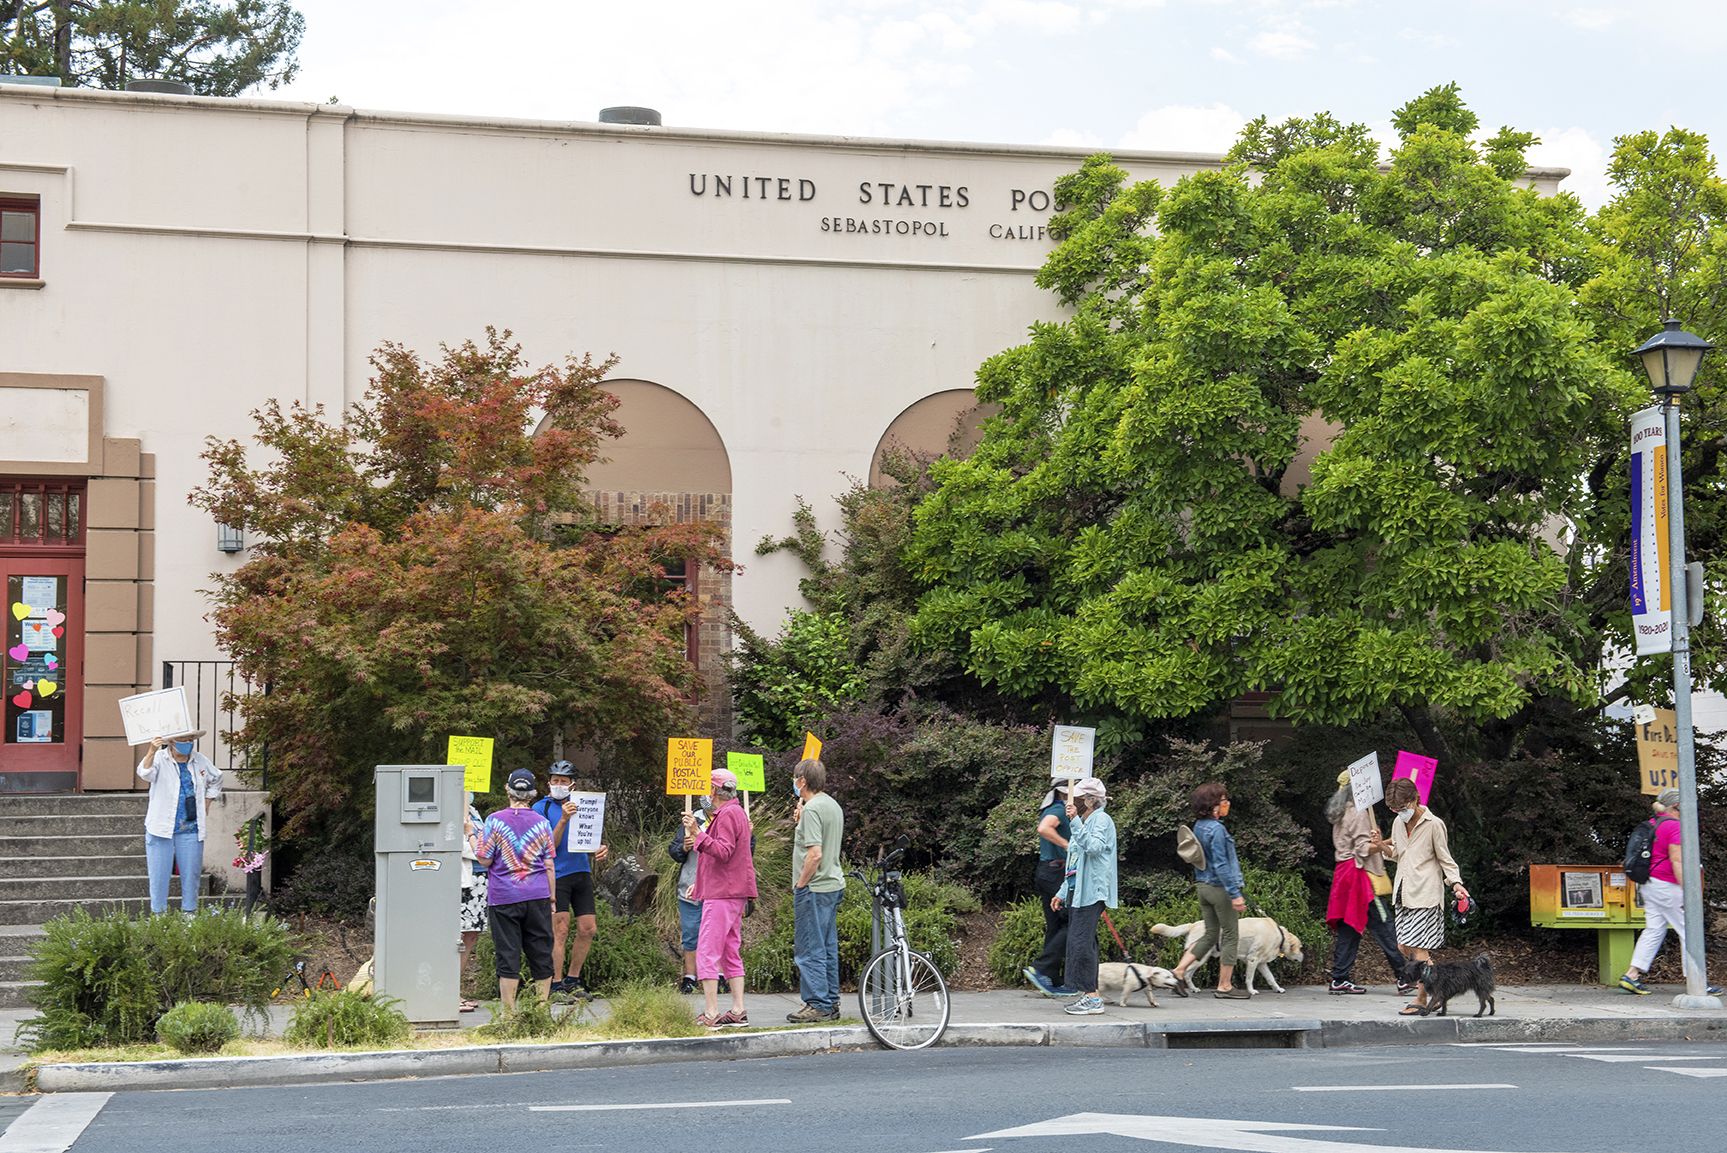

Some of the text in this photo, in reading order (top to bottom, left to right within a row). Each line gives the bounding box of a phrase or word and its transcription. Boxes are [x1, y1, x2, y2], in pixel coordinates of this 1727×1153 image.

[688, 173, 817, 201] UNITED
[859, 181, 970, 208] STATES
[820, 216, 1070, 241] SEBASTOPOL CALIFO
[1643, 426, 1663, 439] YEARS
[1631, 538, 1639, 590] Amendment
[1638, 621, 1670, 635] 1920-2020
[125, 698, 161, 718] Recall
[678, 740, 699, 750] SAVE
[673, 757, 702, 767] PUBLIC
[672, 767, 701, 778] POSTAL
[1648, 768, 1677, 787] USP
[670, 778, 706, 790] SERVICE
